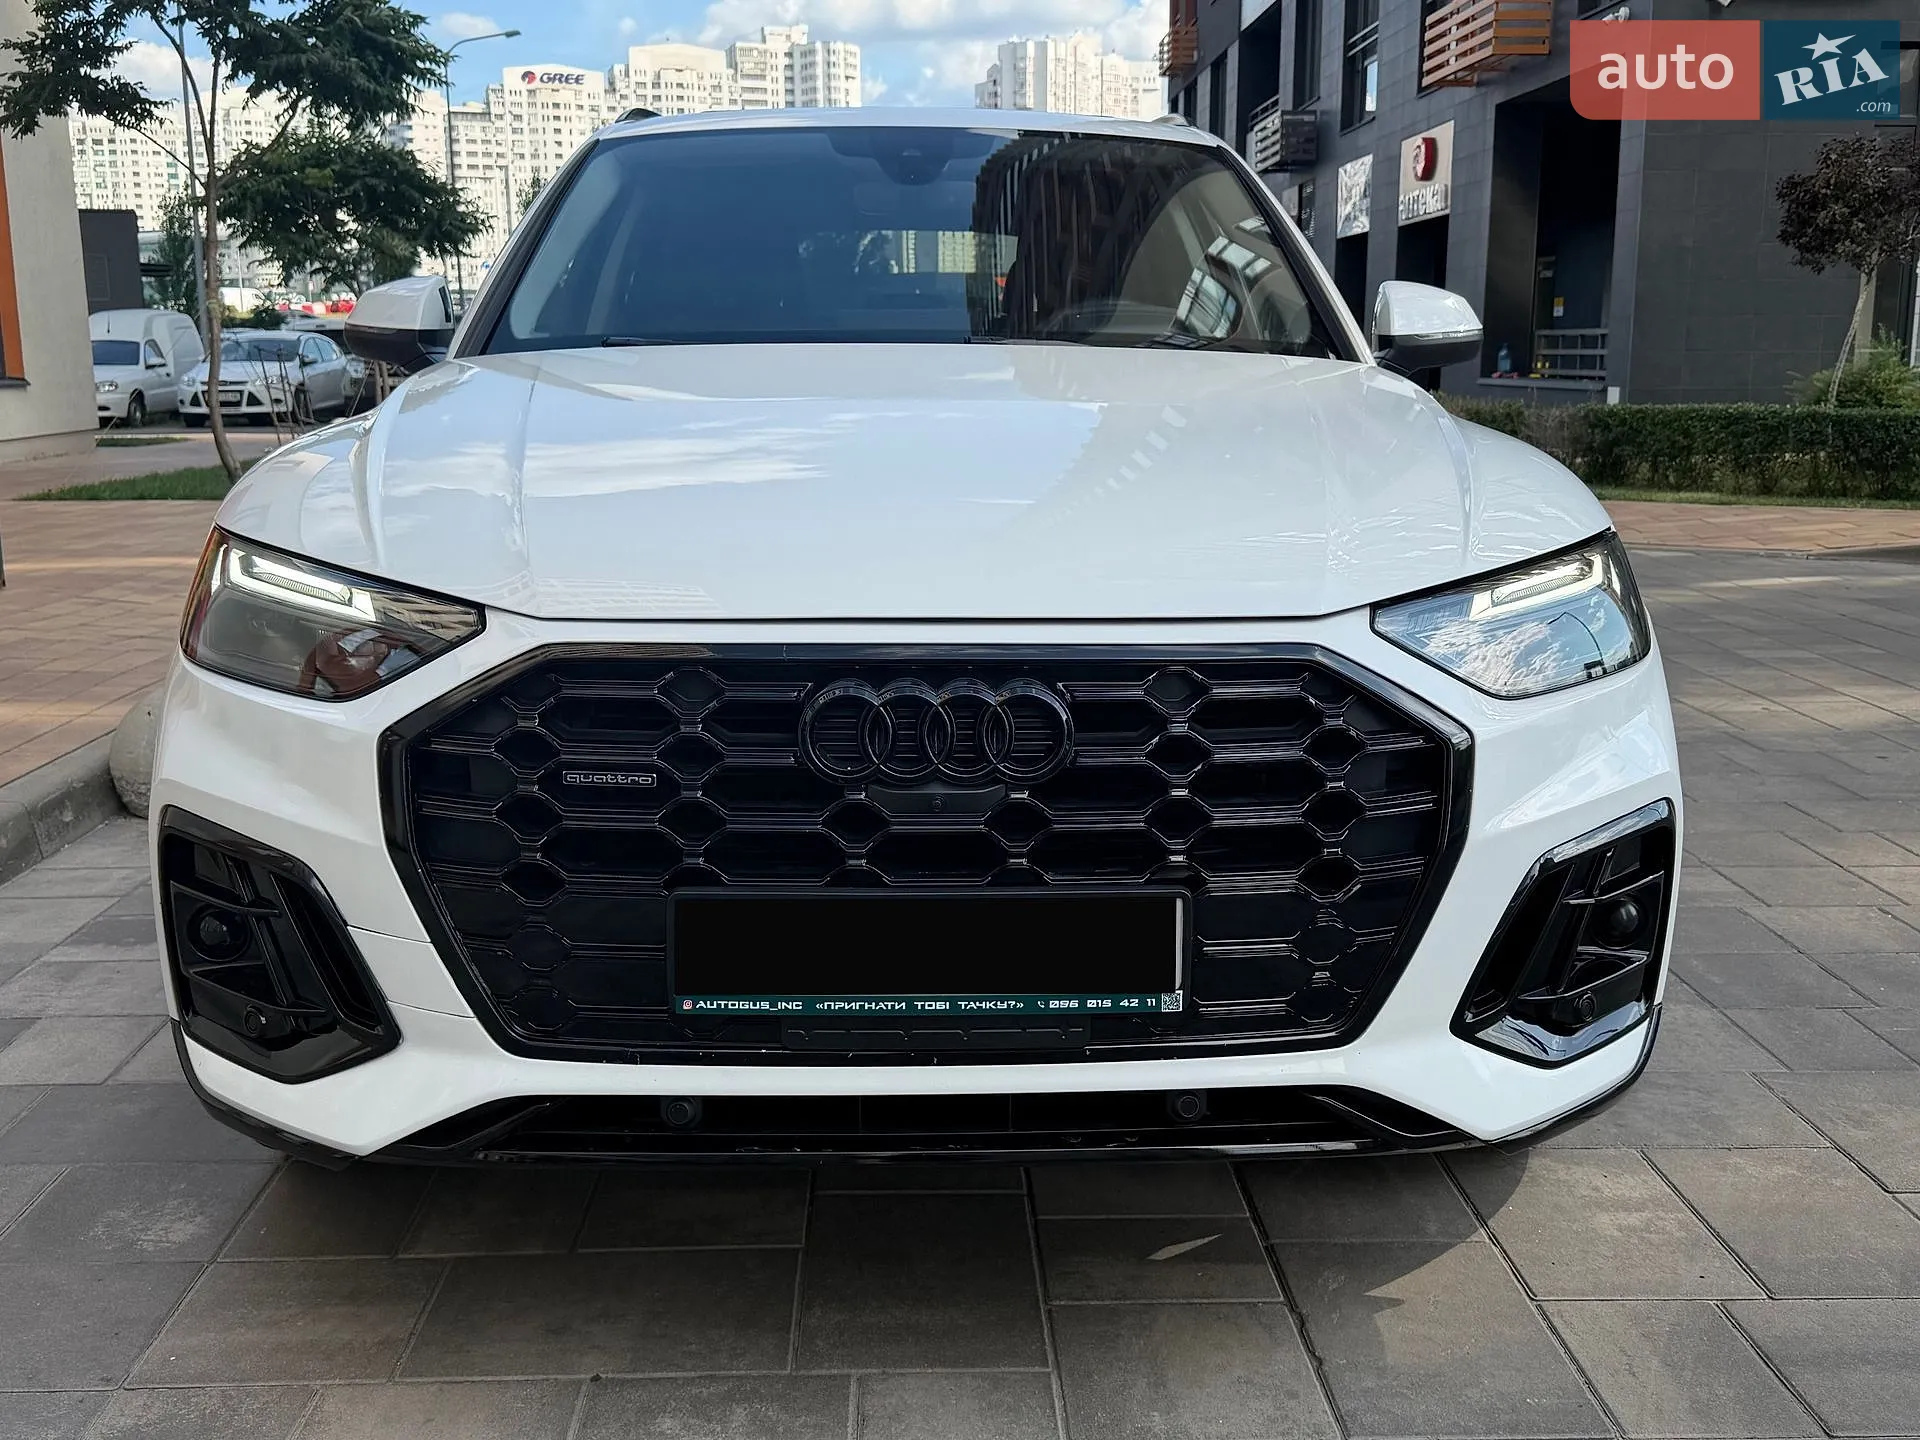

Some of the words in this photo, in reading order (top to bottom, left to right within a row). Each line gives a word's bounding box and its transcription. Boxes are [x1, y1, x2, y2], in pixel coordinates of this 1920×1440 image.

[540, 72, 585, 85] GREE
[566, 774, 652, 784] quattro
[695, 1000, 803, 1011] AUTOGUS_INC
[815, 1000, 907, 1010] «ПРИГНАТИ
[913, 1001, 950, 1010] ТОБІ
[957, 1000, 1025, 1010] ТАЧКУ?»
[1086, 998, 1113, 1009] 015
[1119, 998, 1140, 1008] 42
[1146, 997, 1157, 1007] 11
